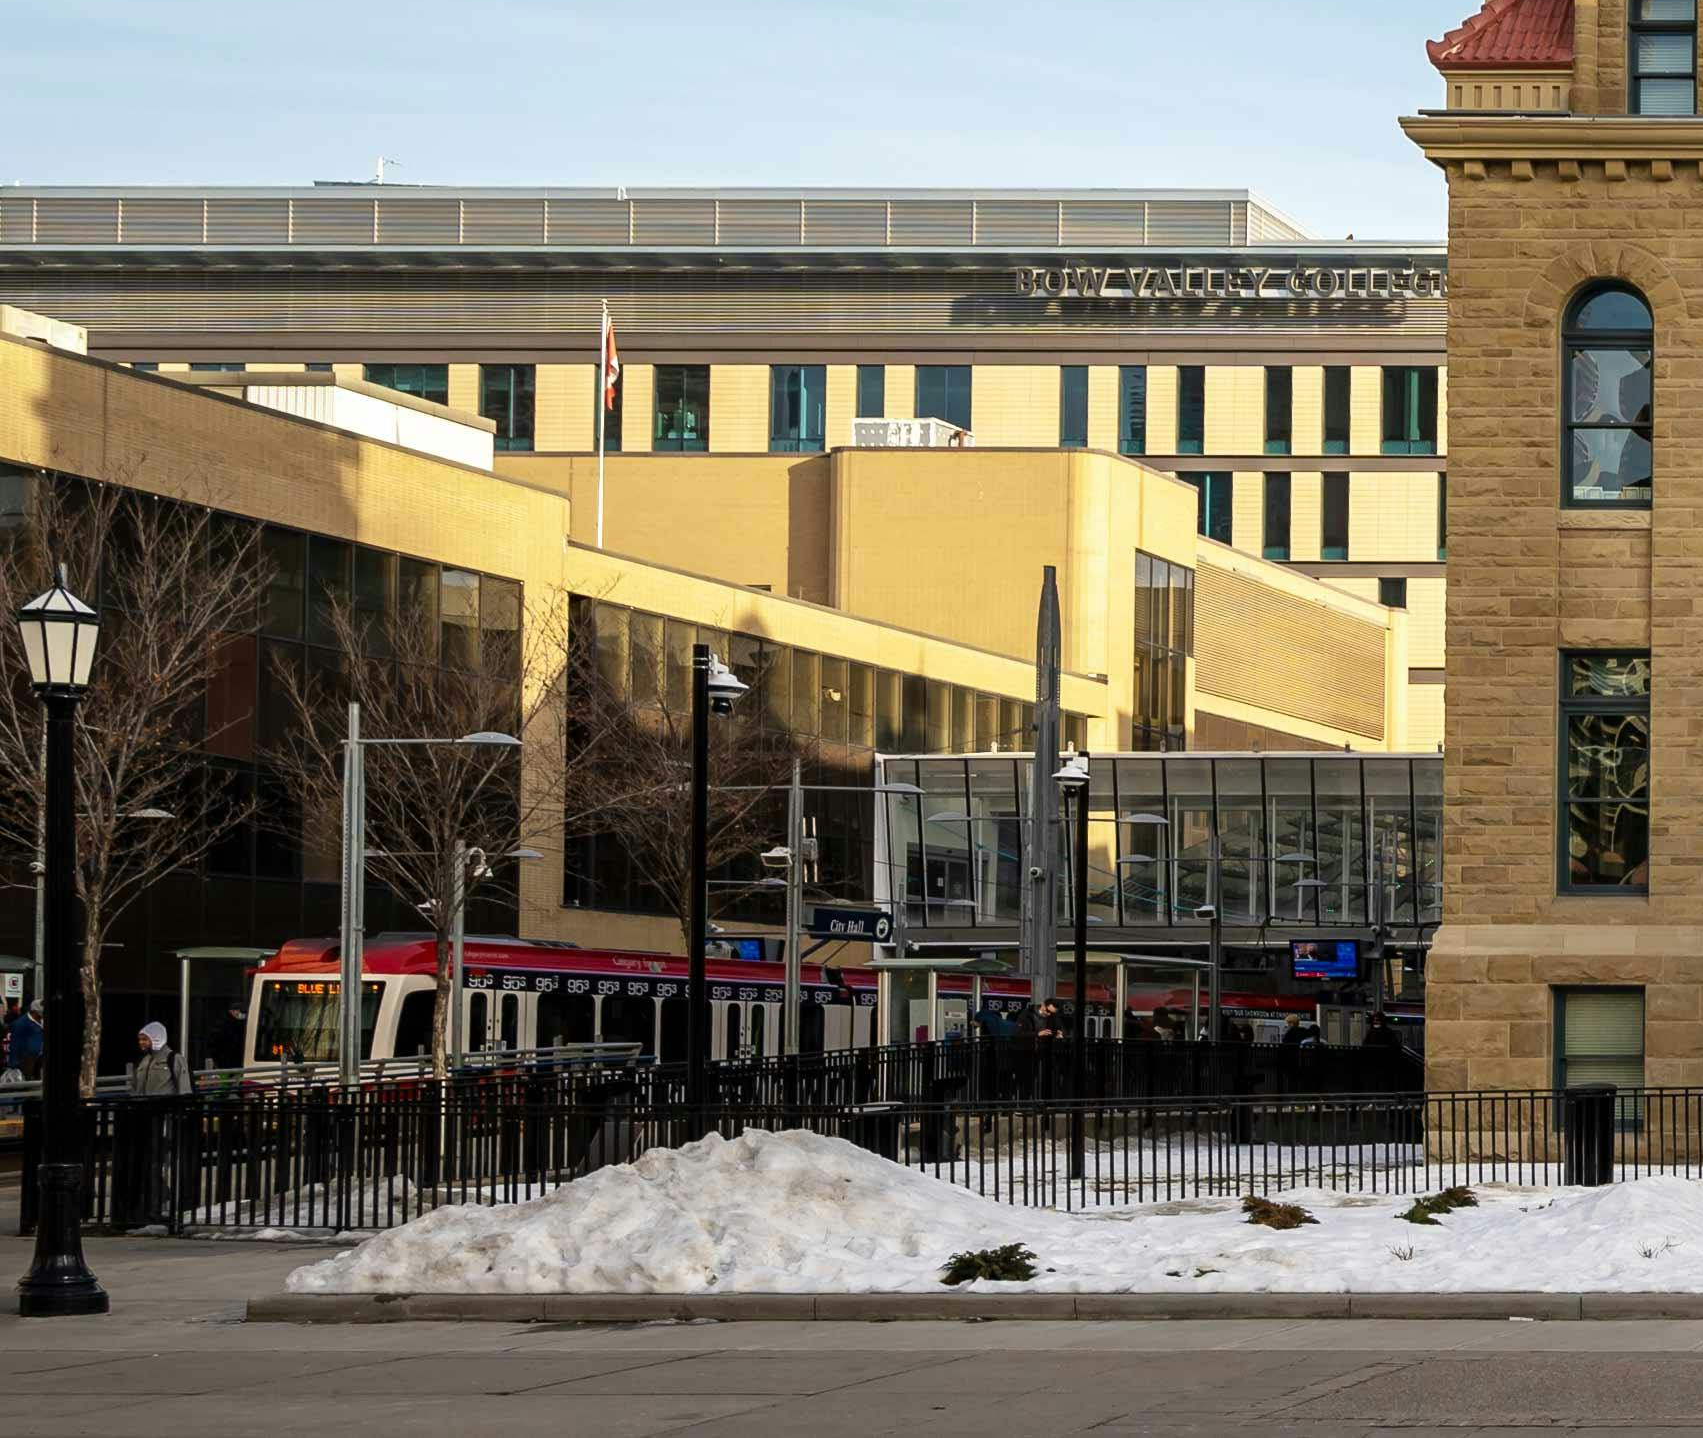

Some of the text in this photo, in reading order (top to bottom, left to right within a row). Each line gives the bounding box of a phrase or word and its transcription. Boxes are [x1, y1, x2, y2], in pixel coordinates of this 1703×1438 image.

[1015, 267, 1109, 296] BOW
[1125, 267, 1273, 297] VALLEY
[830, 919, 864, 933] City Hall
[297, 984, 341, 994] BLUE LI
[568, 979, 590, 993] 953
[598, 981, 620, 994] 953
[627, 982, 649, 996] 953
[657, 983, 677, 997] 953
[712, 986, 732, 999] 953
